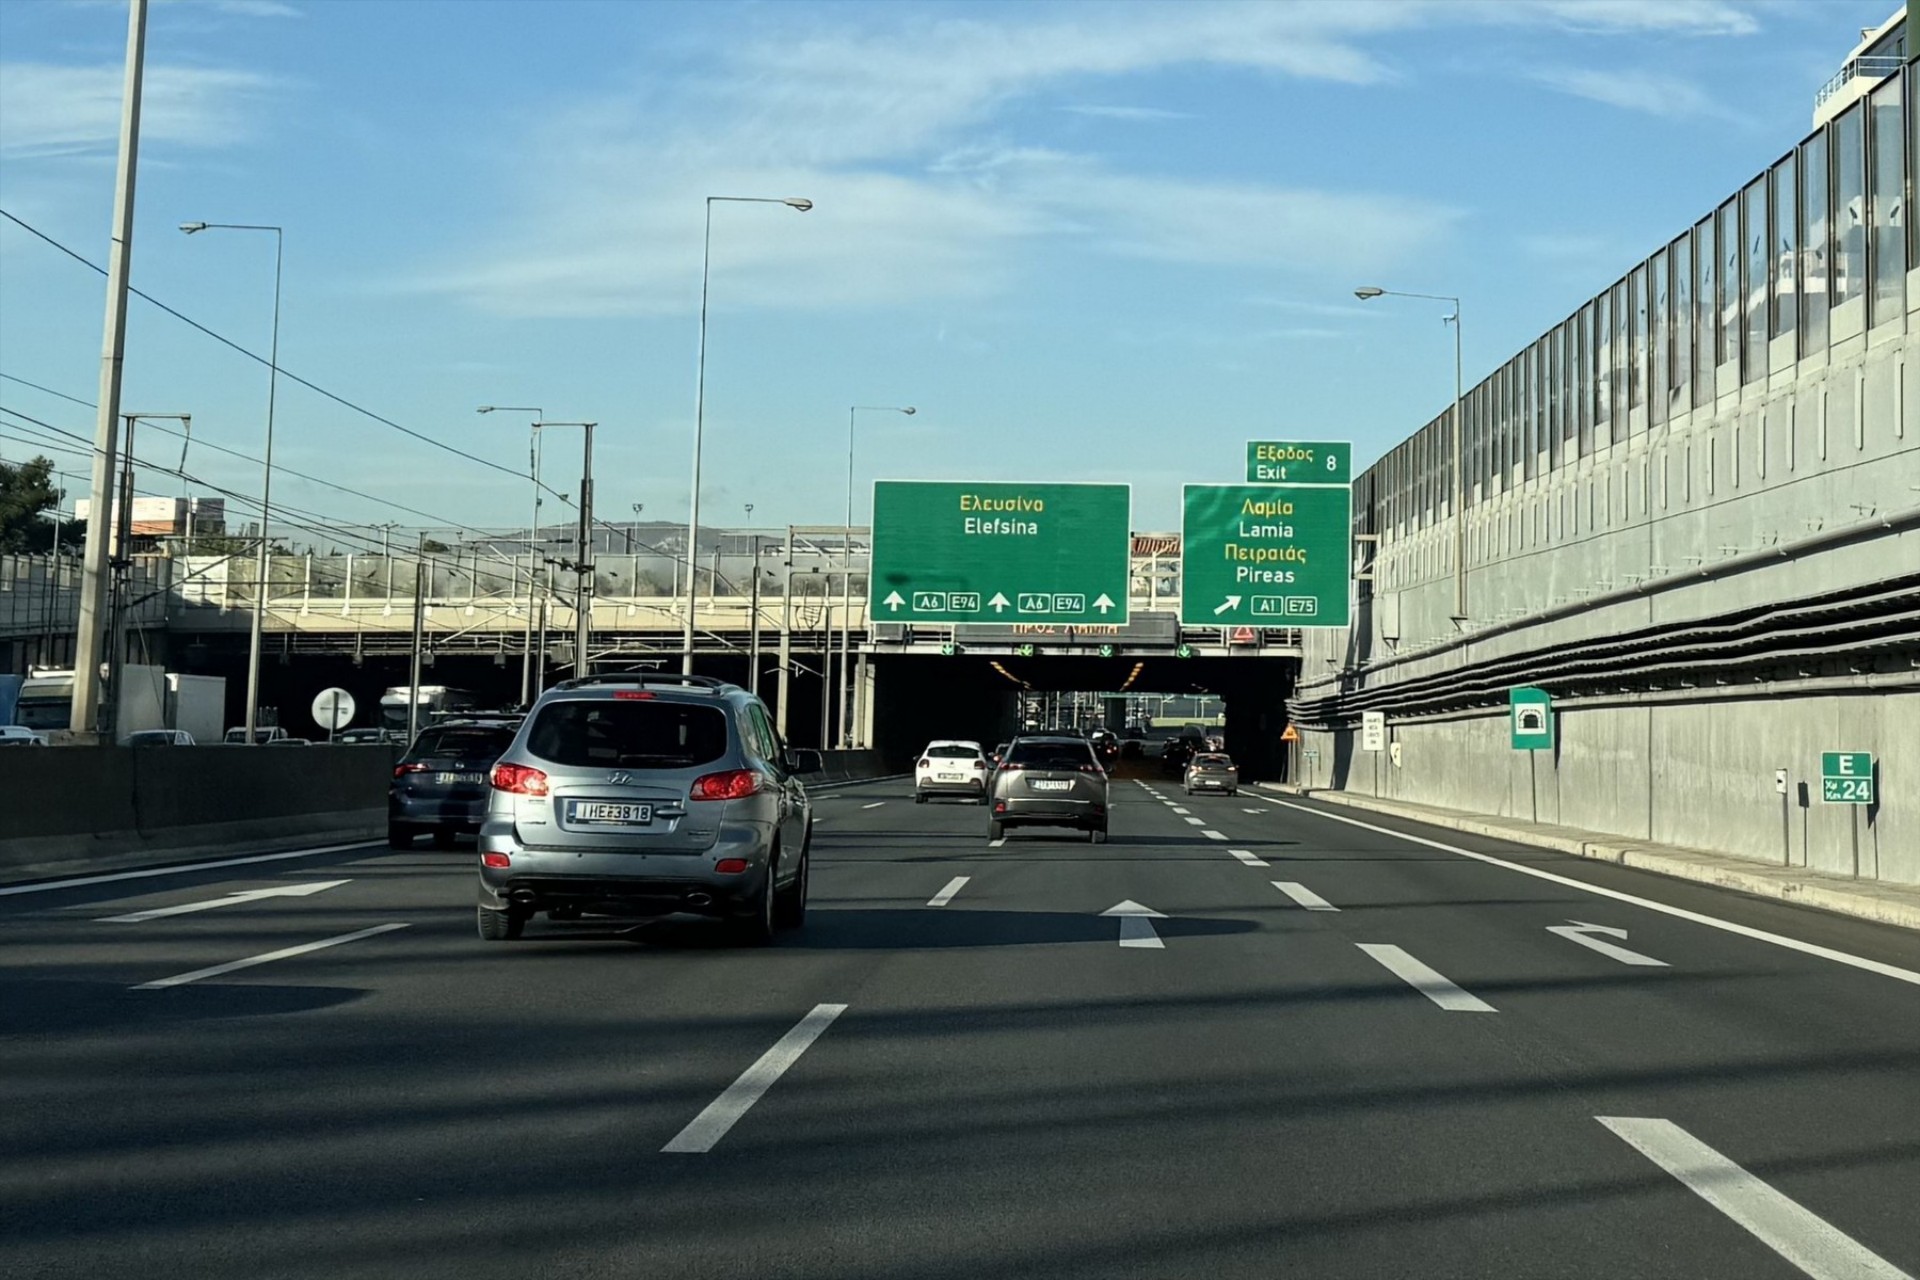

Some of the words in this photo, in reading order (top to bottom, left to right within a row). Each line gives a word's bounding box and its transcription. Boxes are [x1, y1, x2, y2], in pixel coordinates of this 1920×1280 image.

[1326, 455, 1337, 471] 8
[1256, 464, 1287, 480] Exit
[1241, 498, 1293, 518] Λαμία
[964, 517, 1038, 535] Elefsina
[1239, 521, 1294, 538] Lamia
[1225, 543, 1307, 564] Πειραιάς
[1236, 566, 1295, 583] Pireas
[920, 596, 939, 609] A6
[951, 596, 976, 609] E94
[1025, 597, 1043, 610] A6
[1056, 597, 1080, 610] E94
[1260, 599, 1275, 612] A1
[1289, 600, 1313, 612] E75
[1839, 755, 1854, 775] E
[1842, 780, 1870, 800] 24
